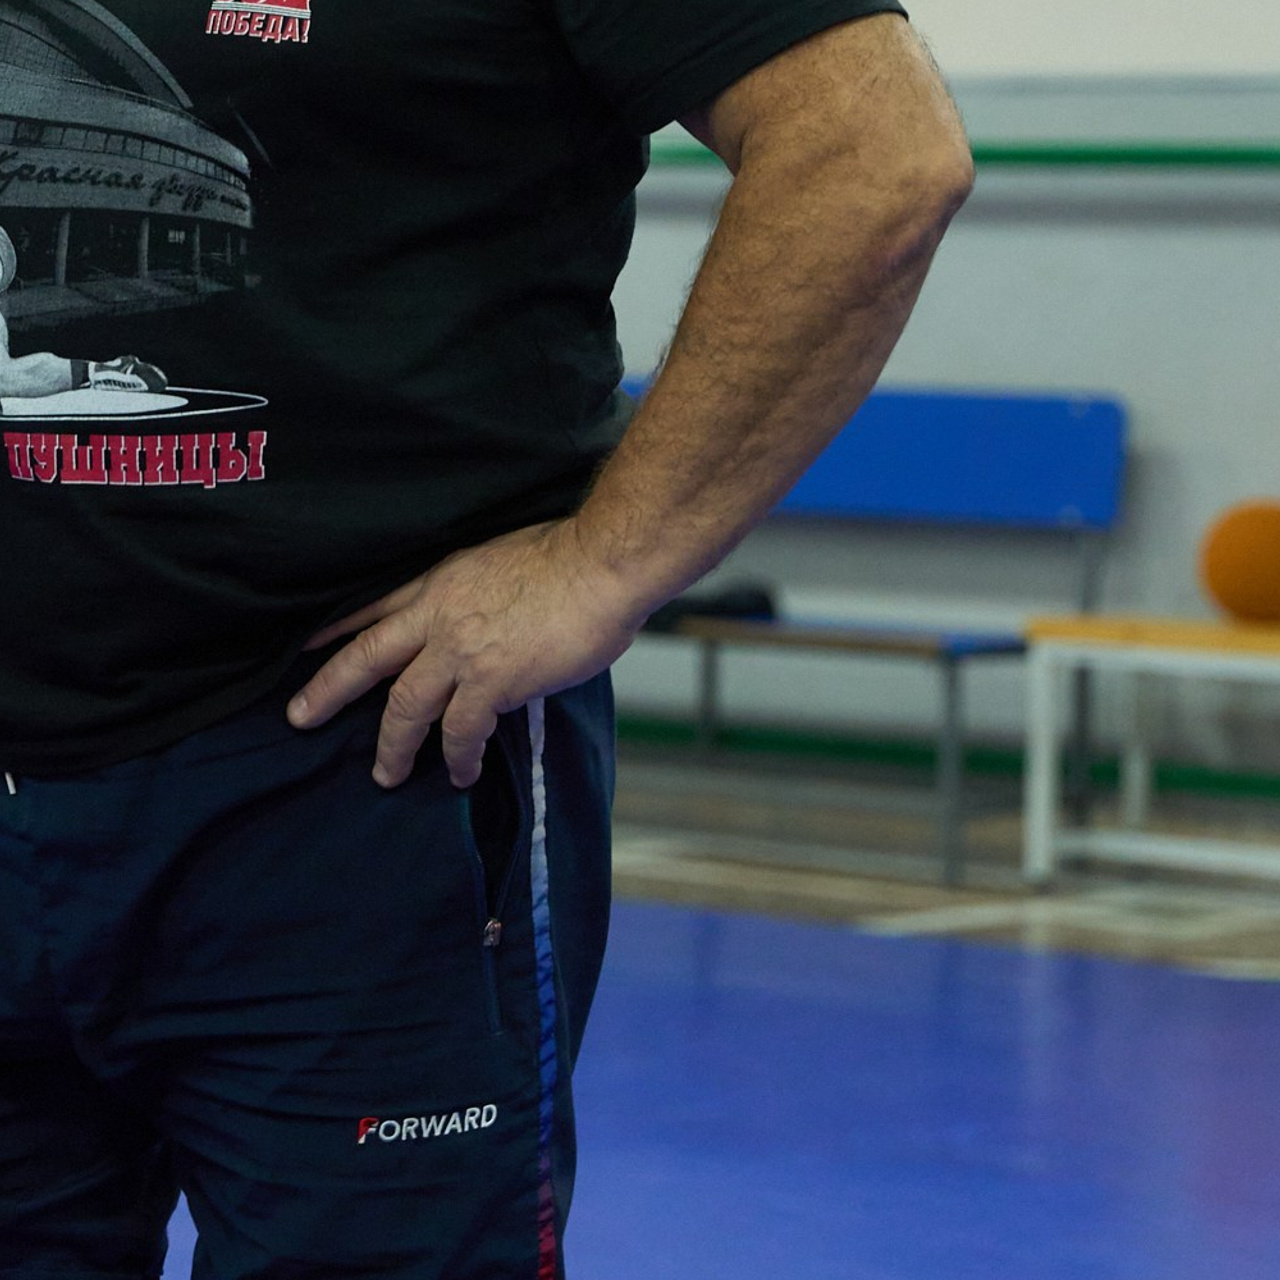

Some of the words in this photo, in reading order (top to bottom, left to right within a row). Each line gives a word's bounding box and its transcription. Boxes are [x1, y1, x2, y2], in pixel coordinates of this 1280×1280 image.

[205, 9, 311, 44] ПОБЕДА!
[2, 430, 268, 489] ПУШНИЦЫ
[357, 1103, 498, 1144] FORWARD
